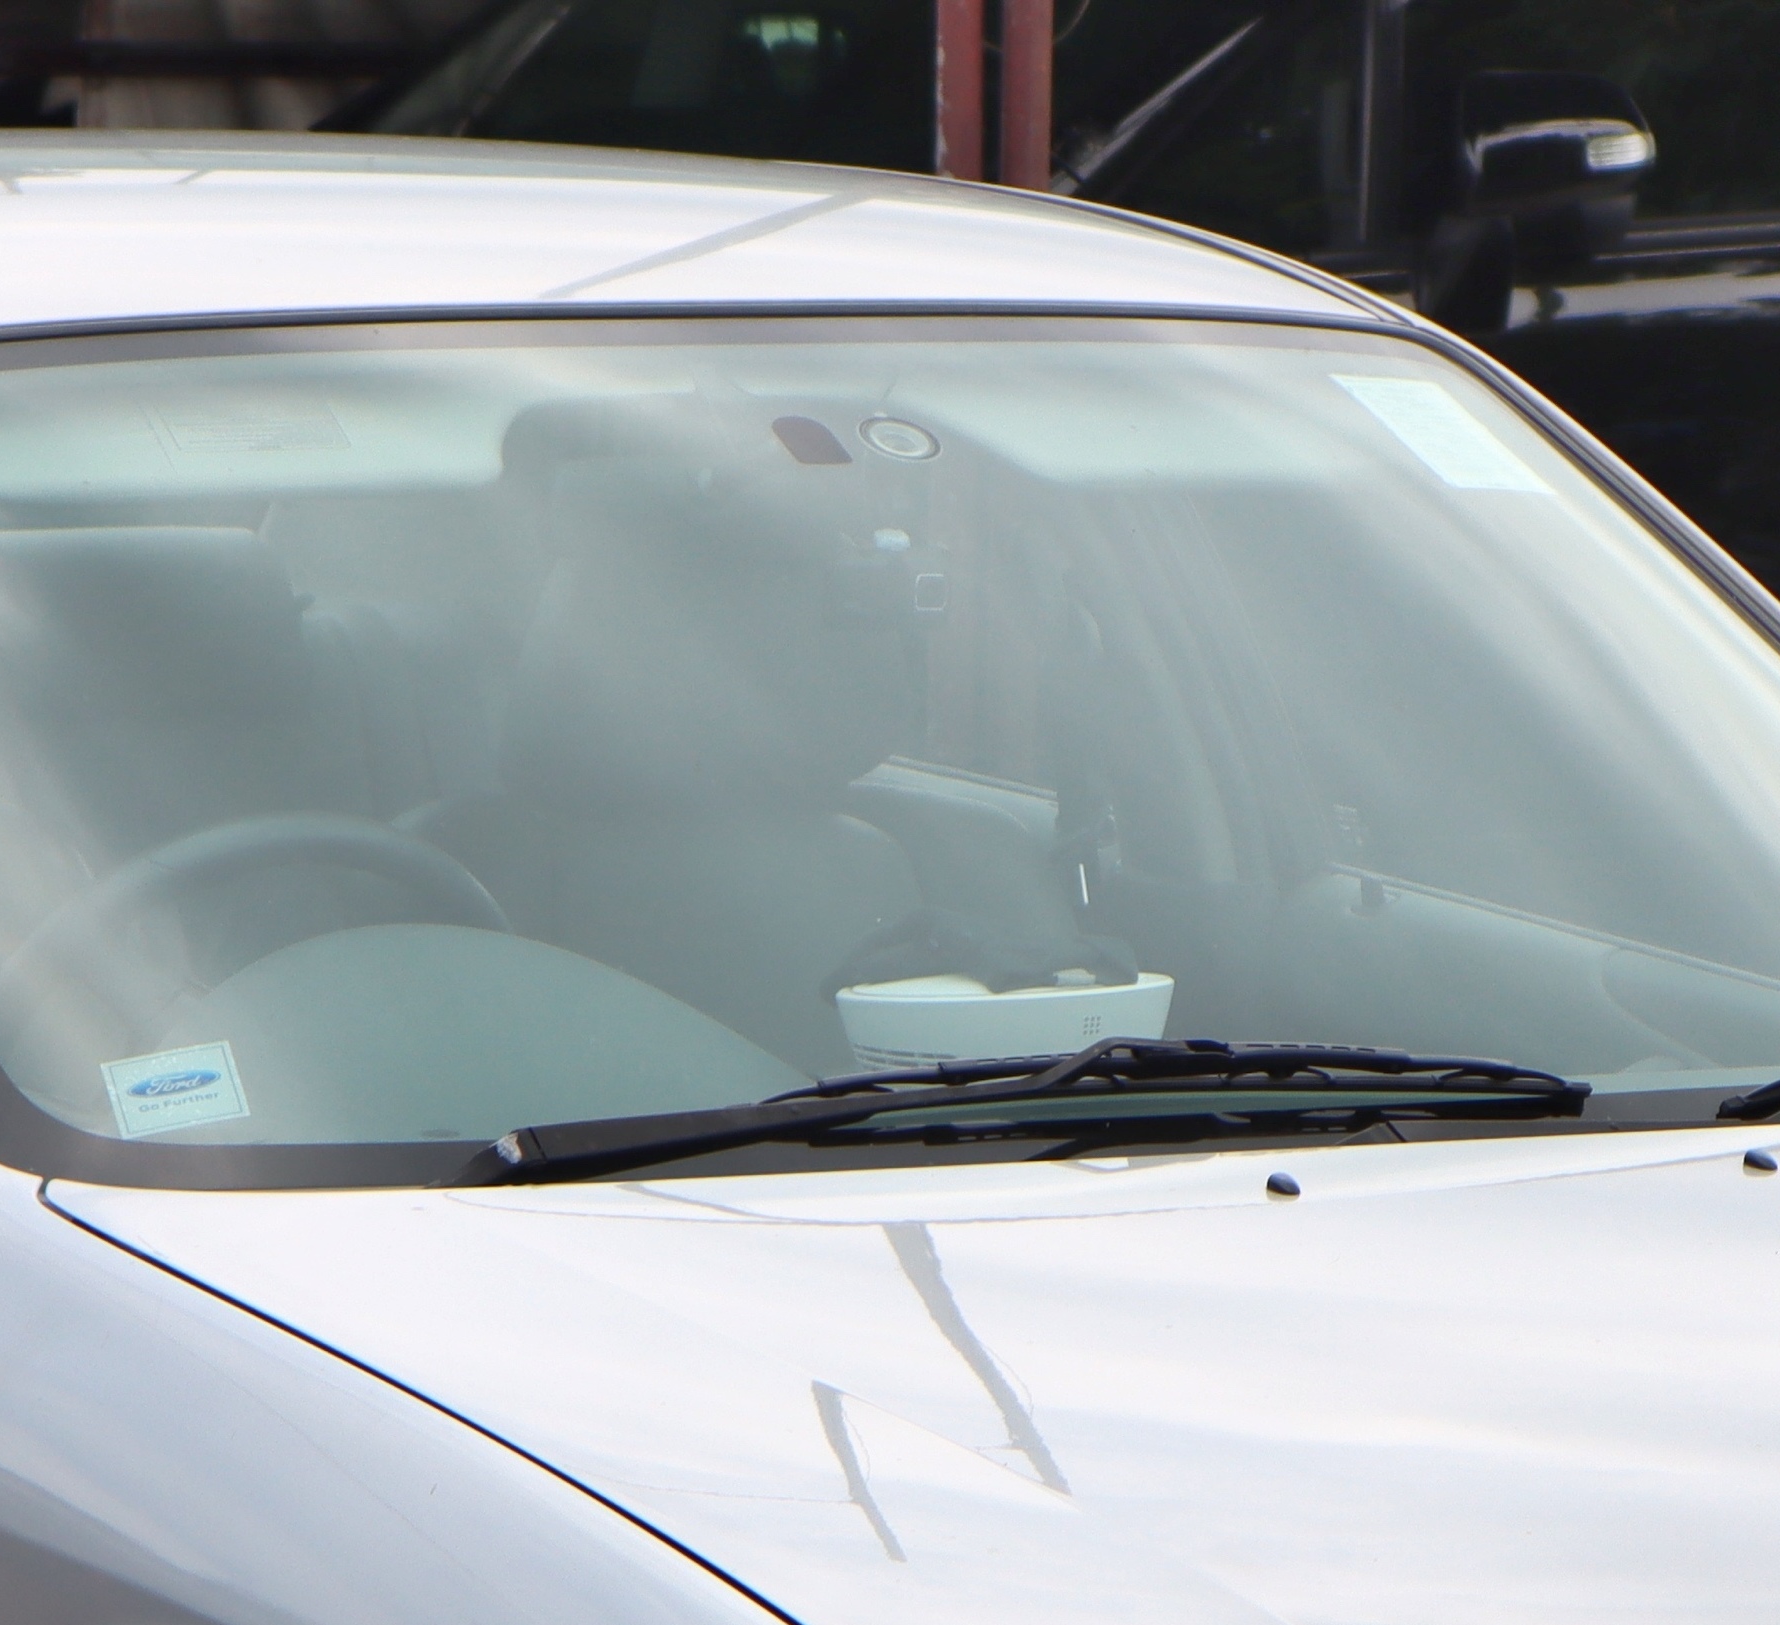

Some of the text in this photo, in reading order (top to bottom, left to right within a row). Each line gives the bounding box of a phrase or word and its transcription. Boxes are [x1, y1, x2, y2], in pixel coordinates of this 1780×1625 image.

[147, 1073, 202, 1096] Ford
[139, 1092, 219, 1113] Go Further
